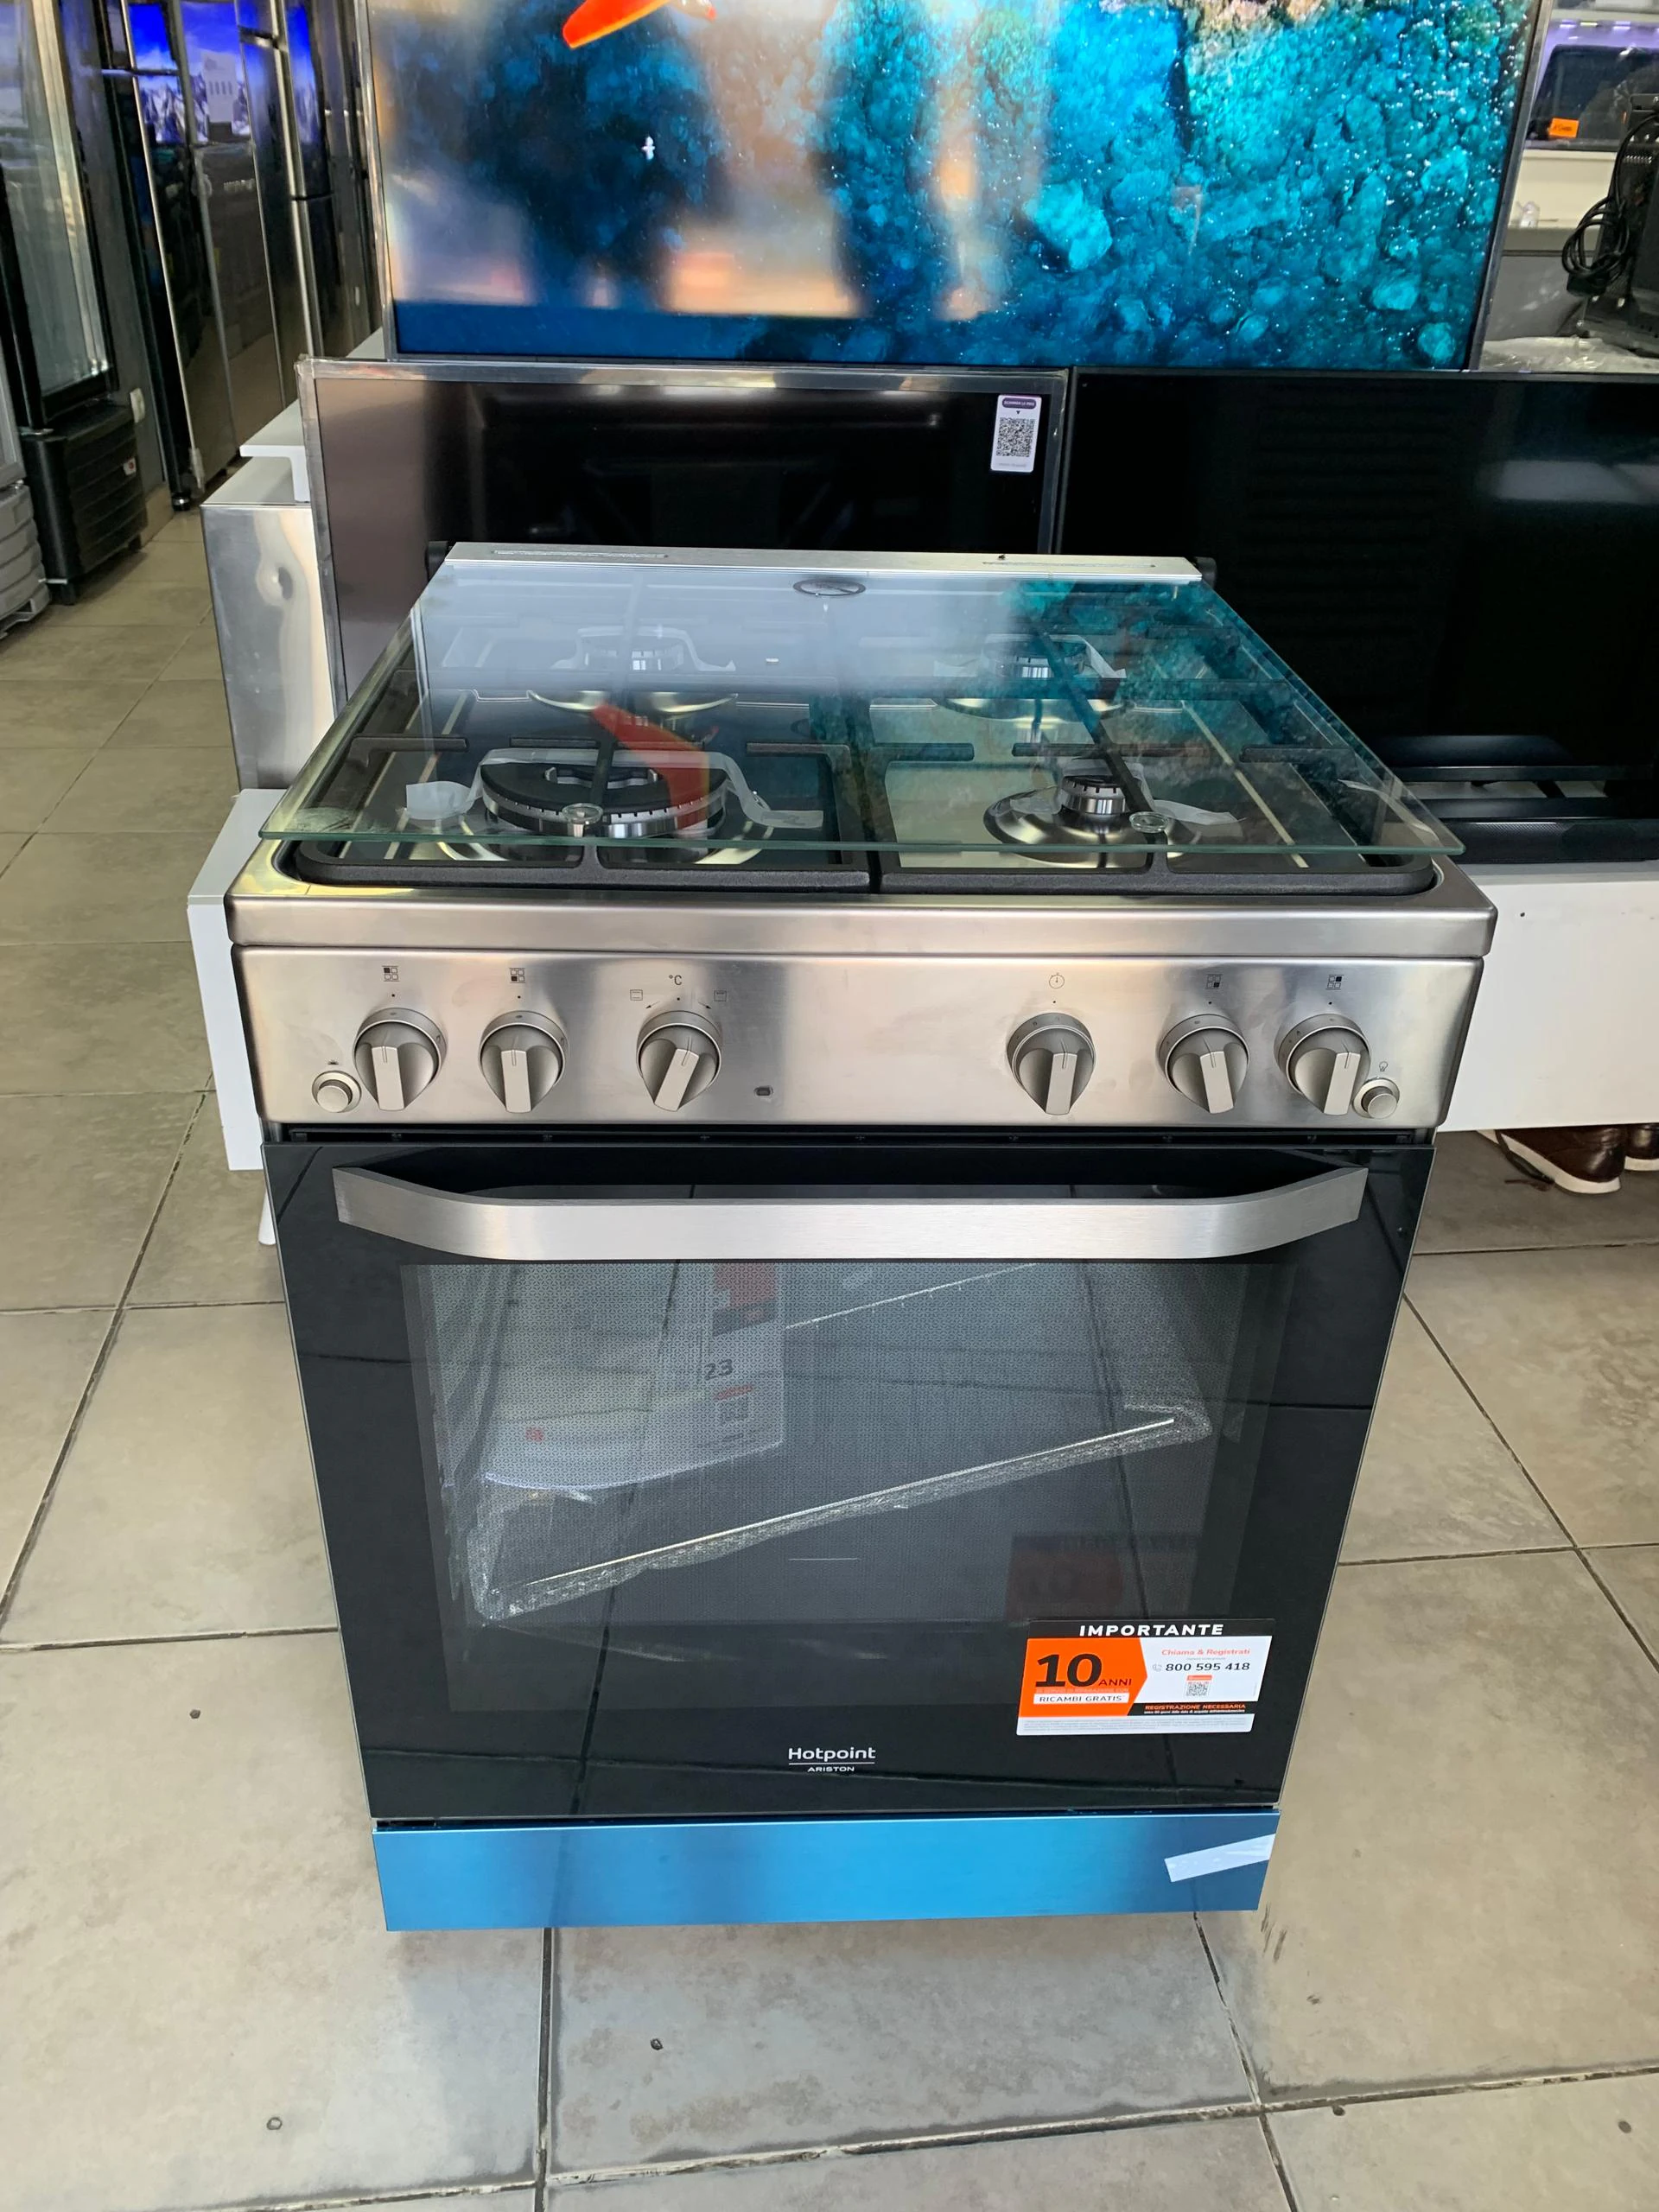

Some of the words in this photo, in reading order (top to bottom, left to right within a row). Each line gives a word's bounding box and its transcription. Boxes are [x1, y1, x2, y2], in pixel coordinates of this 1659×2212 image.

[1079, 1624, 1224, 1637] IMPORTANTE
[1206, 1648, 1251, 1657] Registrati
[1035, 1653, 1103, 1688] 10
[1098, 1678, 1132, 1687] ANNI
[1165, 1663, 1192, 1672] 800
[1196, 1662, 1221, 1671] 595
[1224, 1662, 1250, 1671] 418
[788, 1747, 876, 1763] Hotpoint
